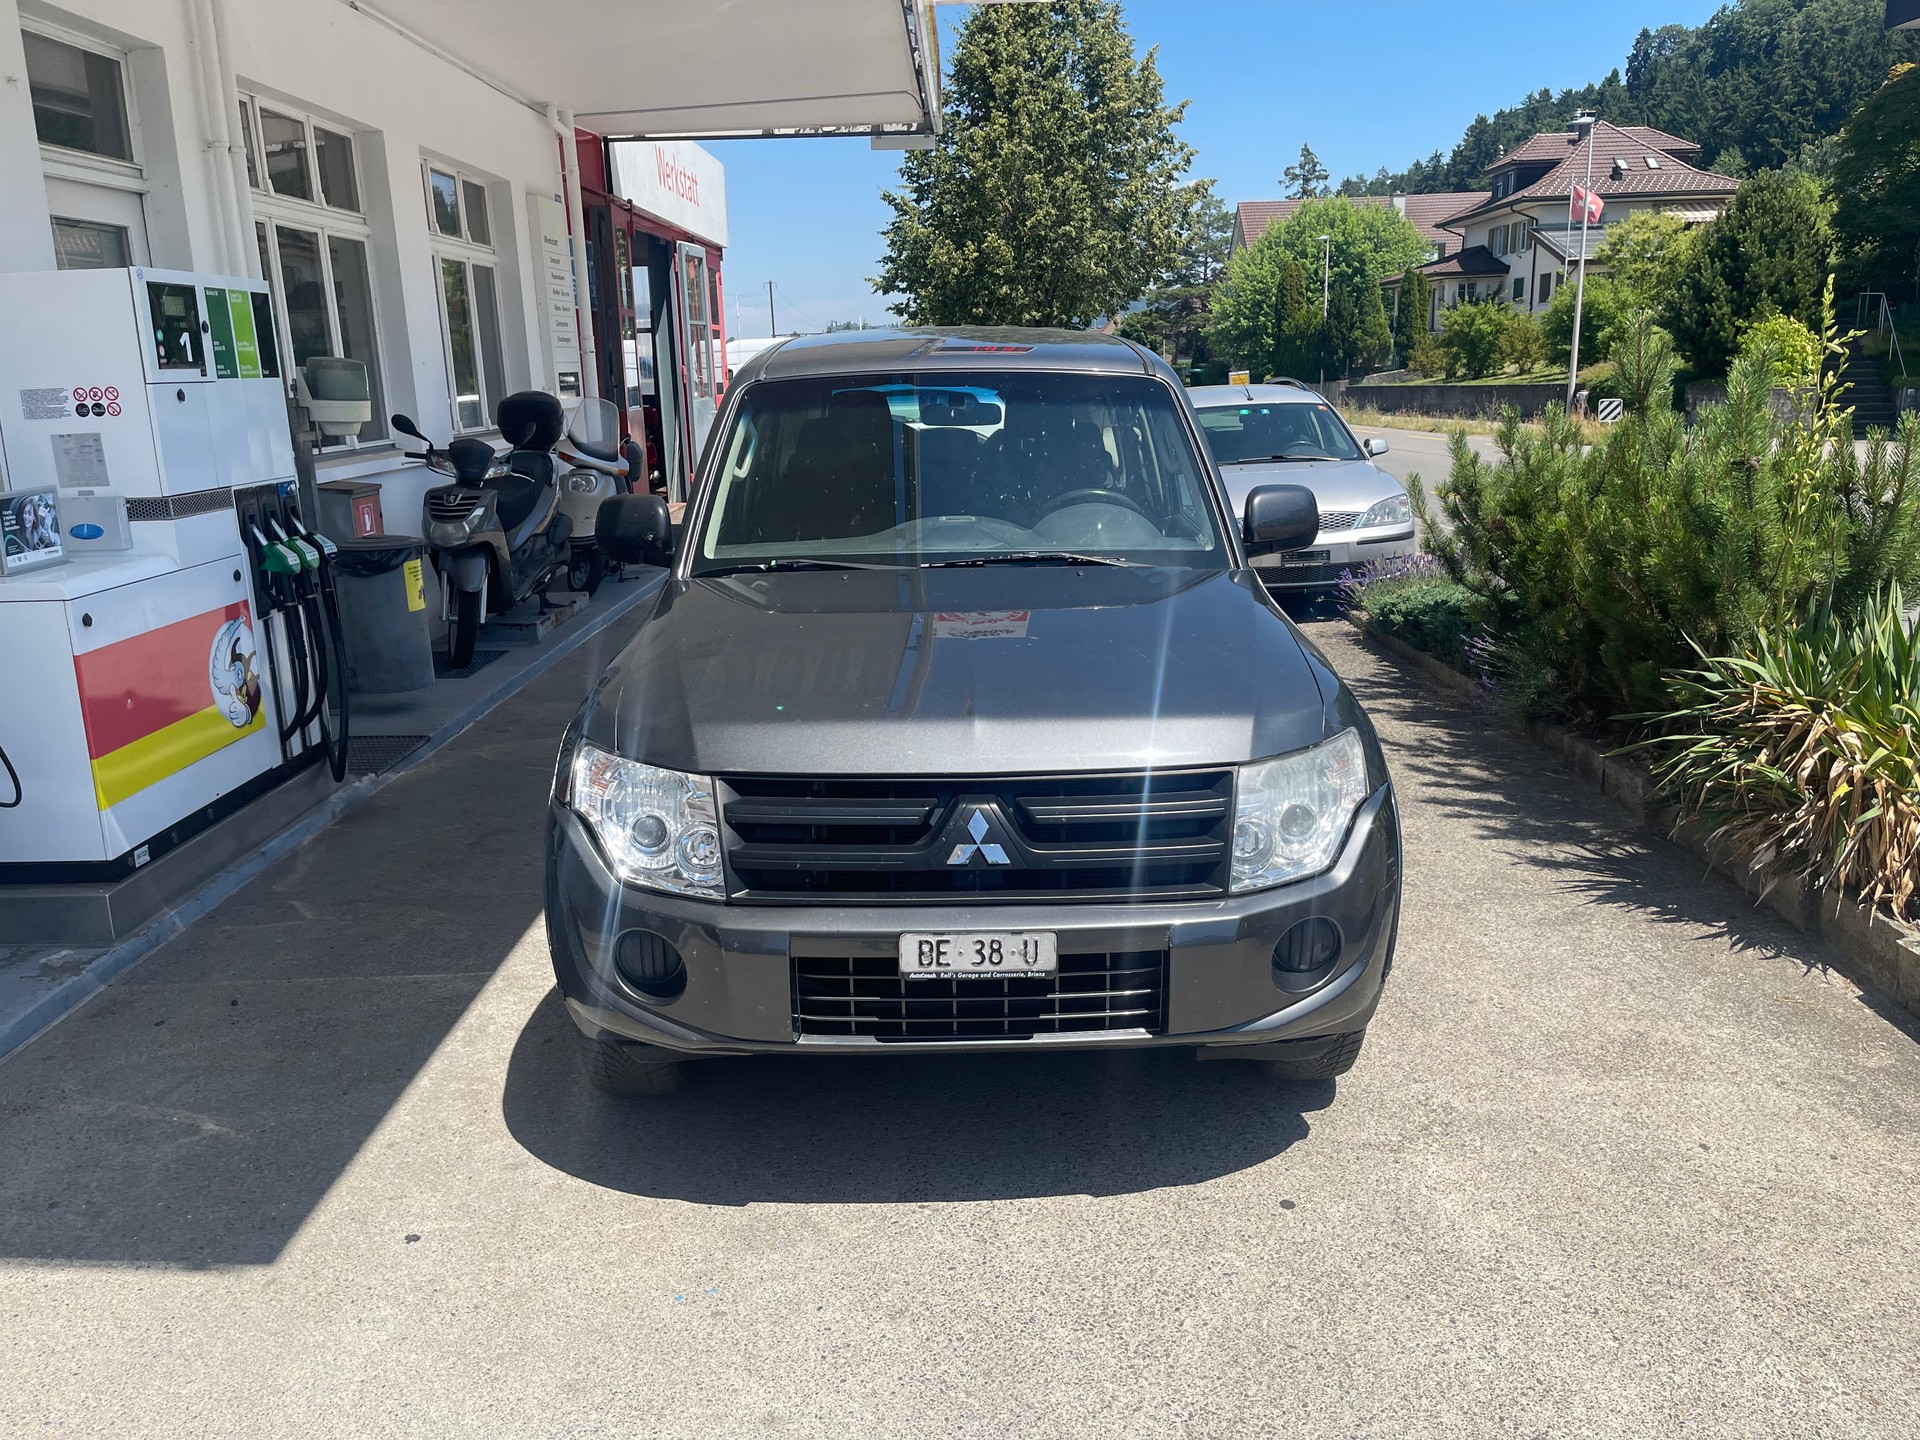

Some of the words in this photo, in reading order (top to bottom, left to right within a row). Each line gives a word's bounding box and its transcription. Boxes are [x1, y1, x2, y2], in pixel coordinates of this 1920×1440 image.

[654, 143, 700, 208] Werkstatt
[179, 331, 193, 362] 1
[918, 938, 951, 967] BE
[971, 938, 1004, 967] 38
[1022, 938, 1039, 966] U
[957, 972, 979, 980] Garage
